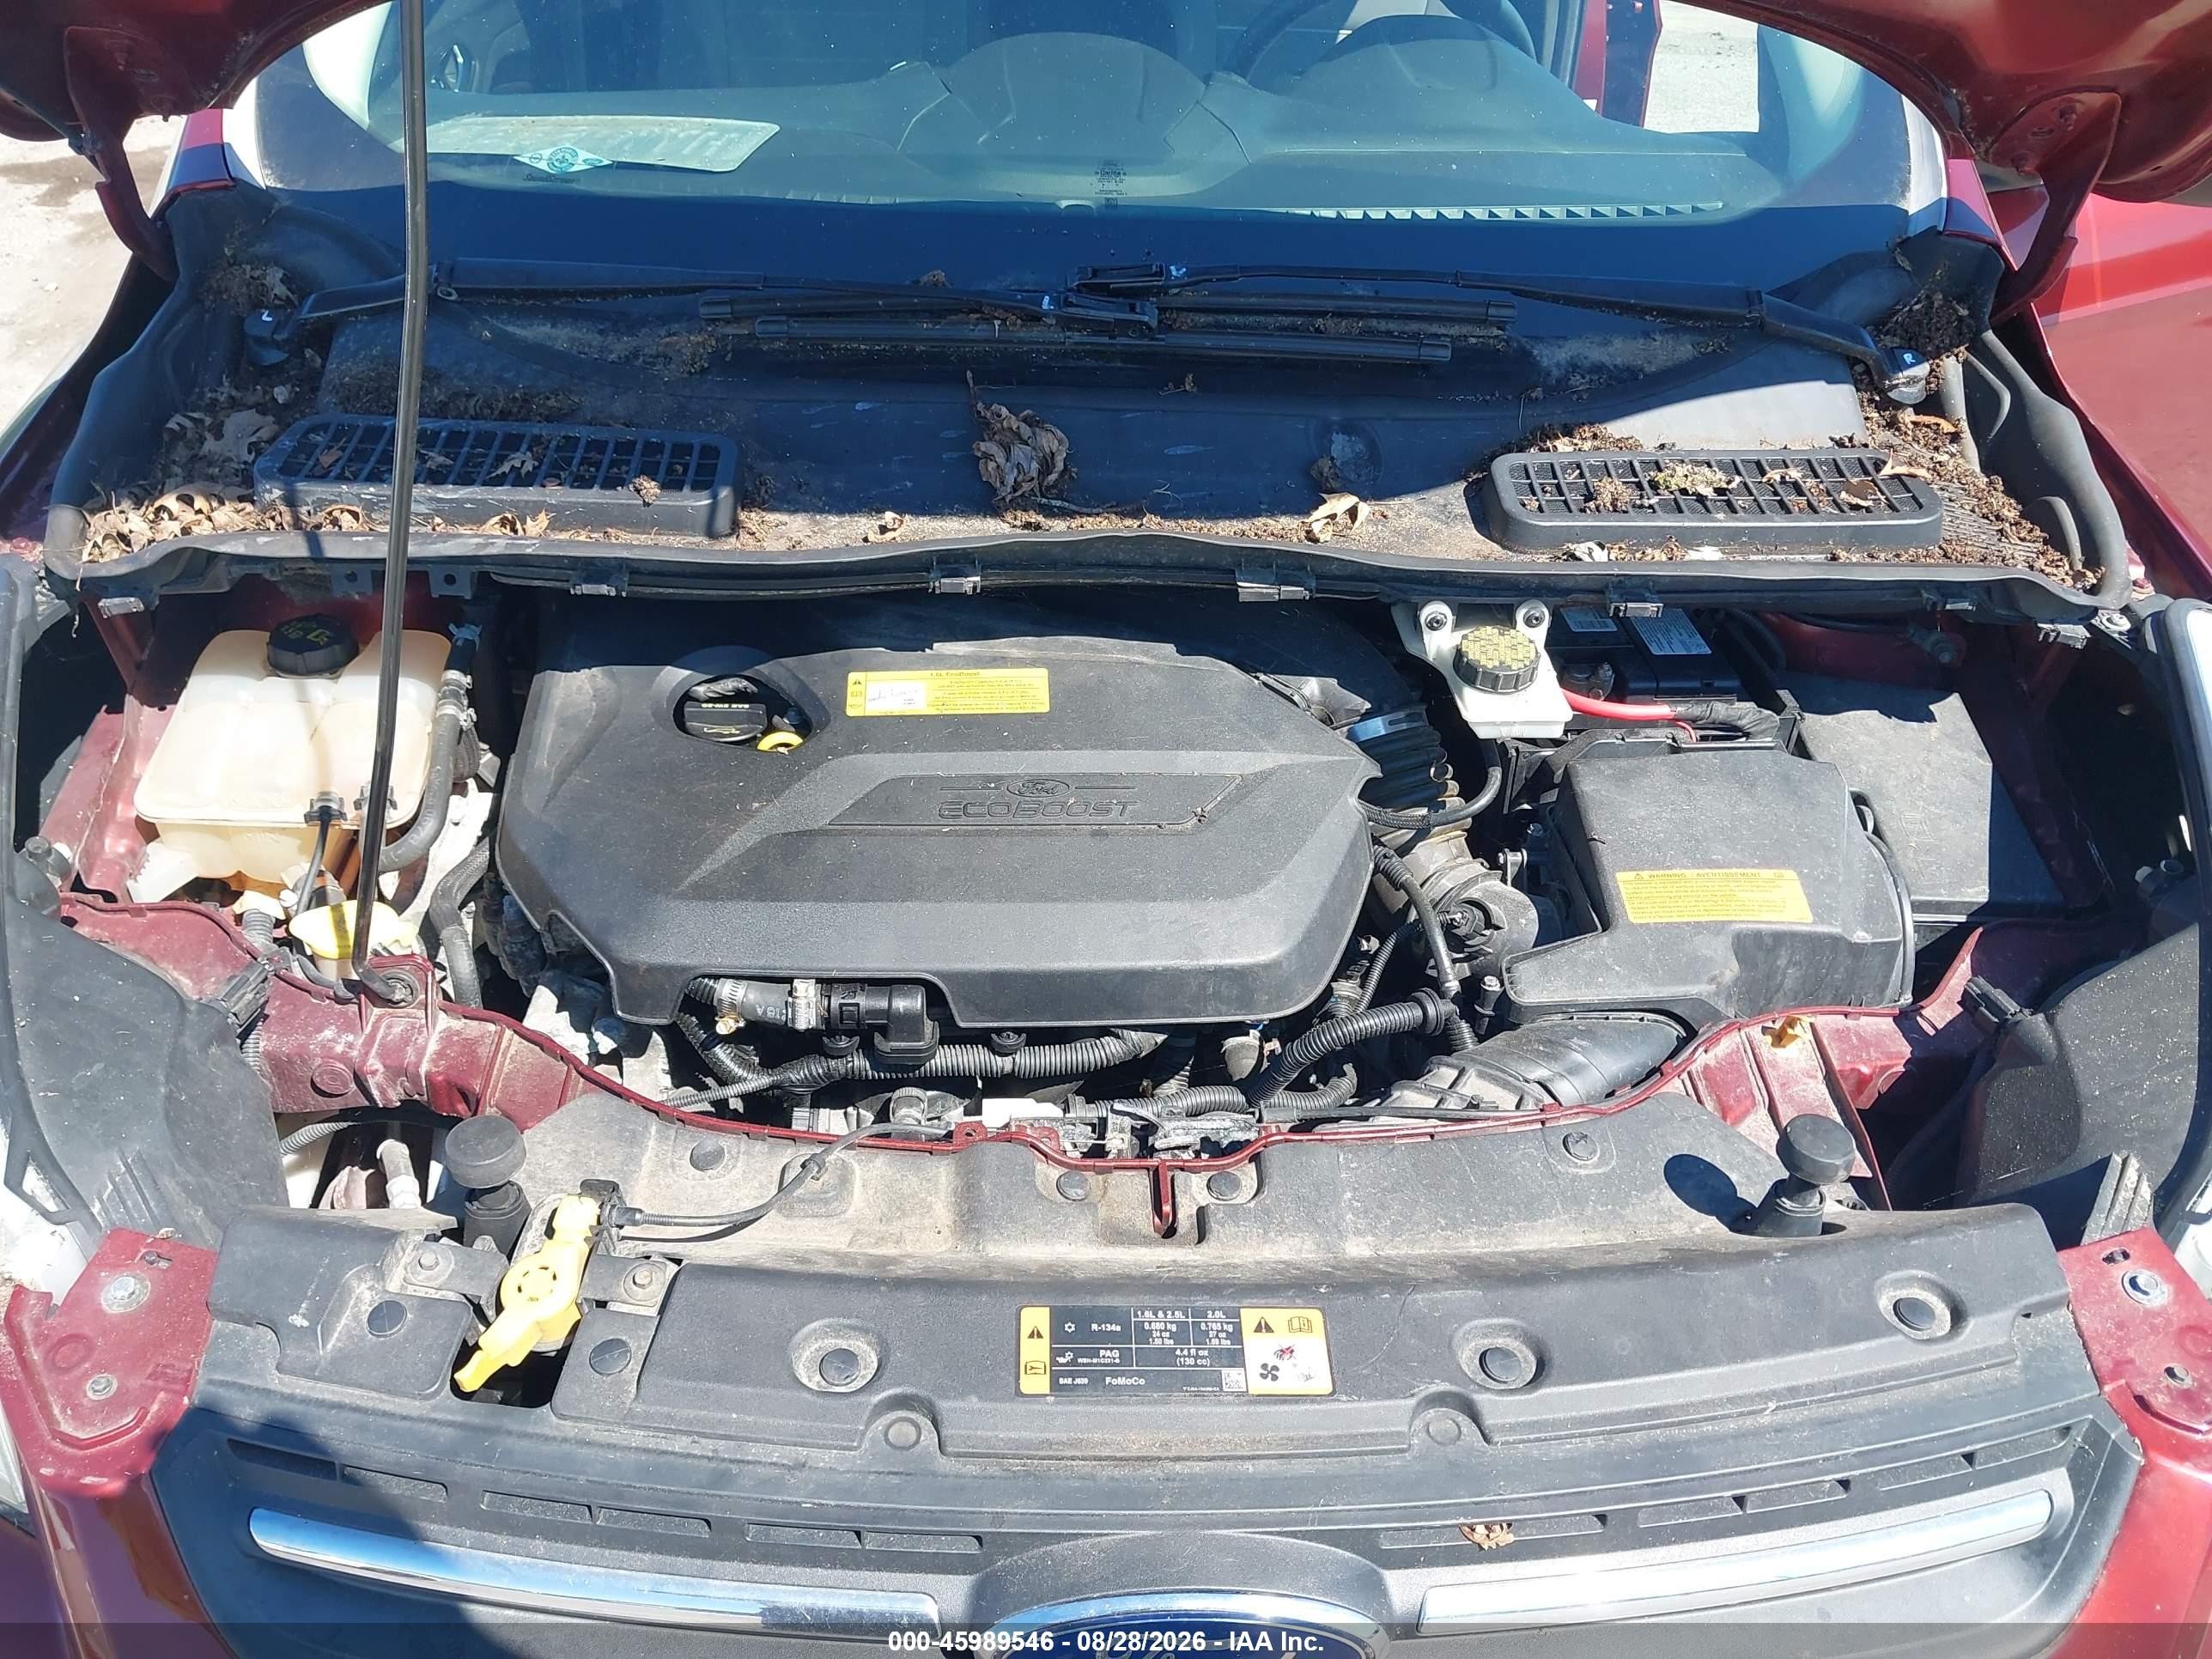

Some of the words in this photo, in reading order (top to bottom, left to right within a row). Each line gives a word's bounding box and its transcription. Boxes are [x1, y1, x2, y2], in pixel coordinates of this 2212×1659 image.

[1903, 353, 1917, 365] R
[1137, 1310, 1156, 1319] 1.6L
[1166, 1310, 1186, 1319] 2.5L
[1206, 1310, 1226, 1319] 2.0L
[1091, 1323, 1121, 1332] R-134a
[1144, 1322, 1165, 1330] 0.680
[1167, 1322, 1177, 1332] kg
[1200, 1322, 1222, 1331] 0.765
[1223, 1323, 1234, 1333] kg
[1099, 1349, 1120, 1358] PAG
[1176, 1358, 1195, 1367] (130
[1196, 1358, 1211, 1367] cc)
[1105, 1376, 1146, 1385] FoMoCo
